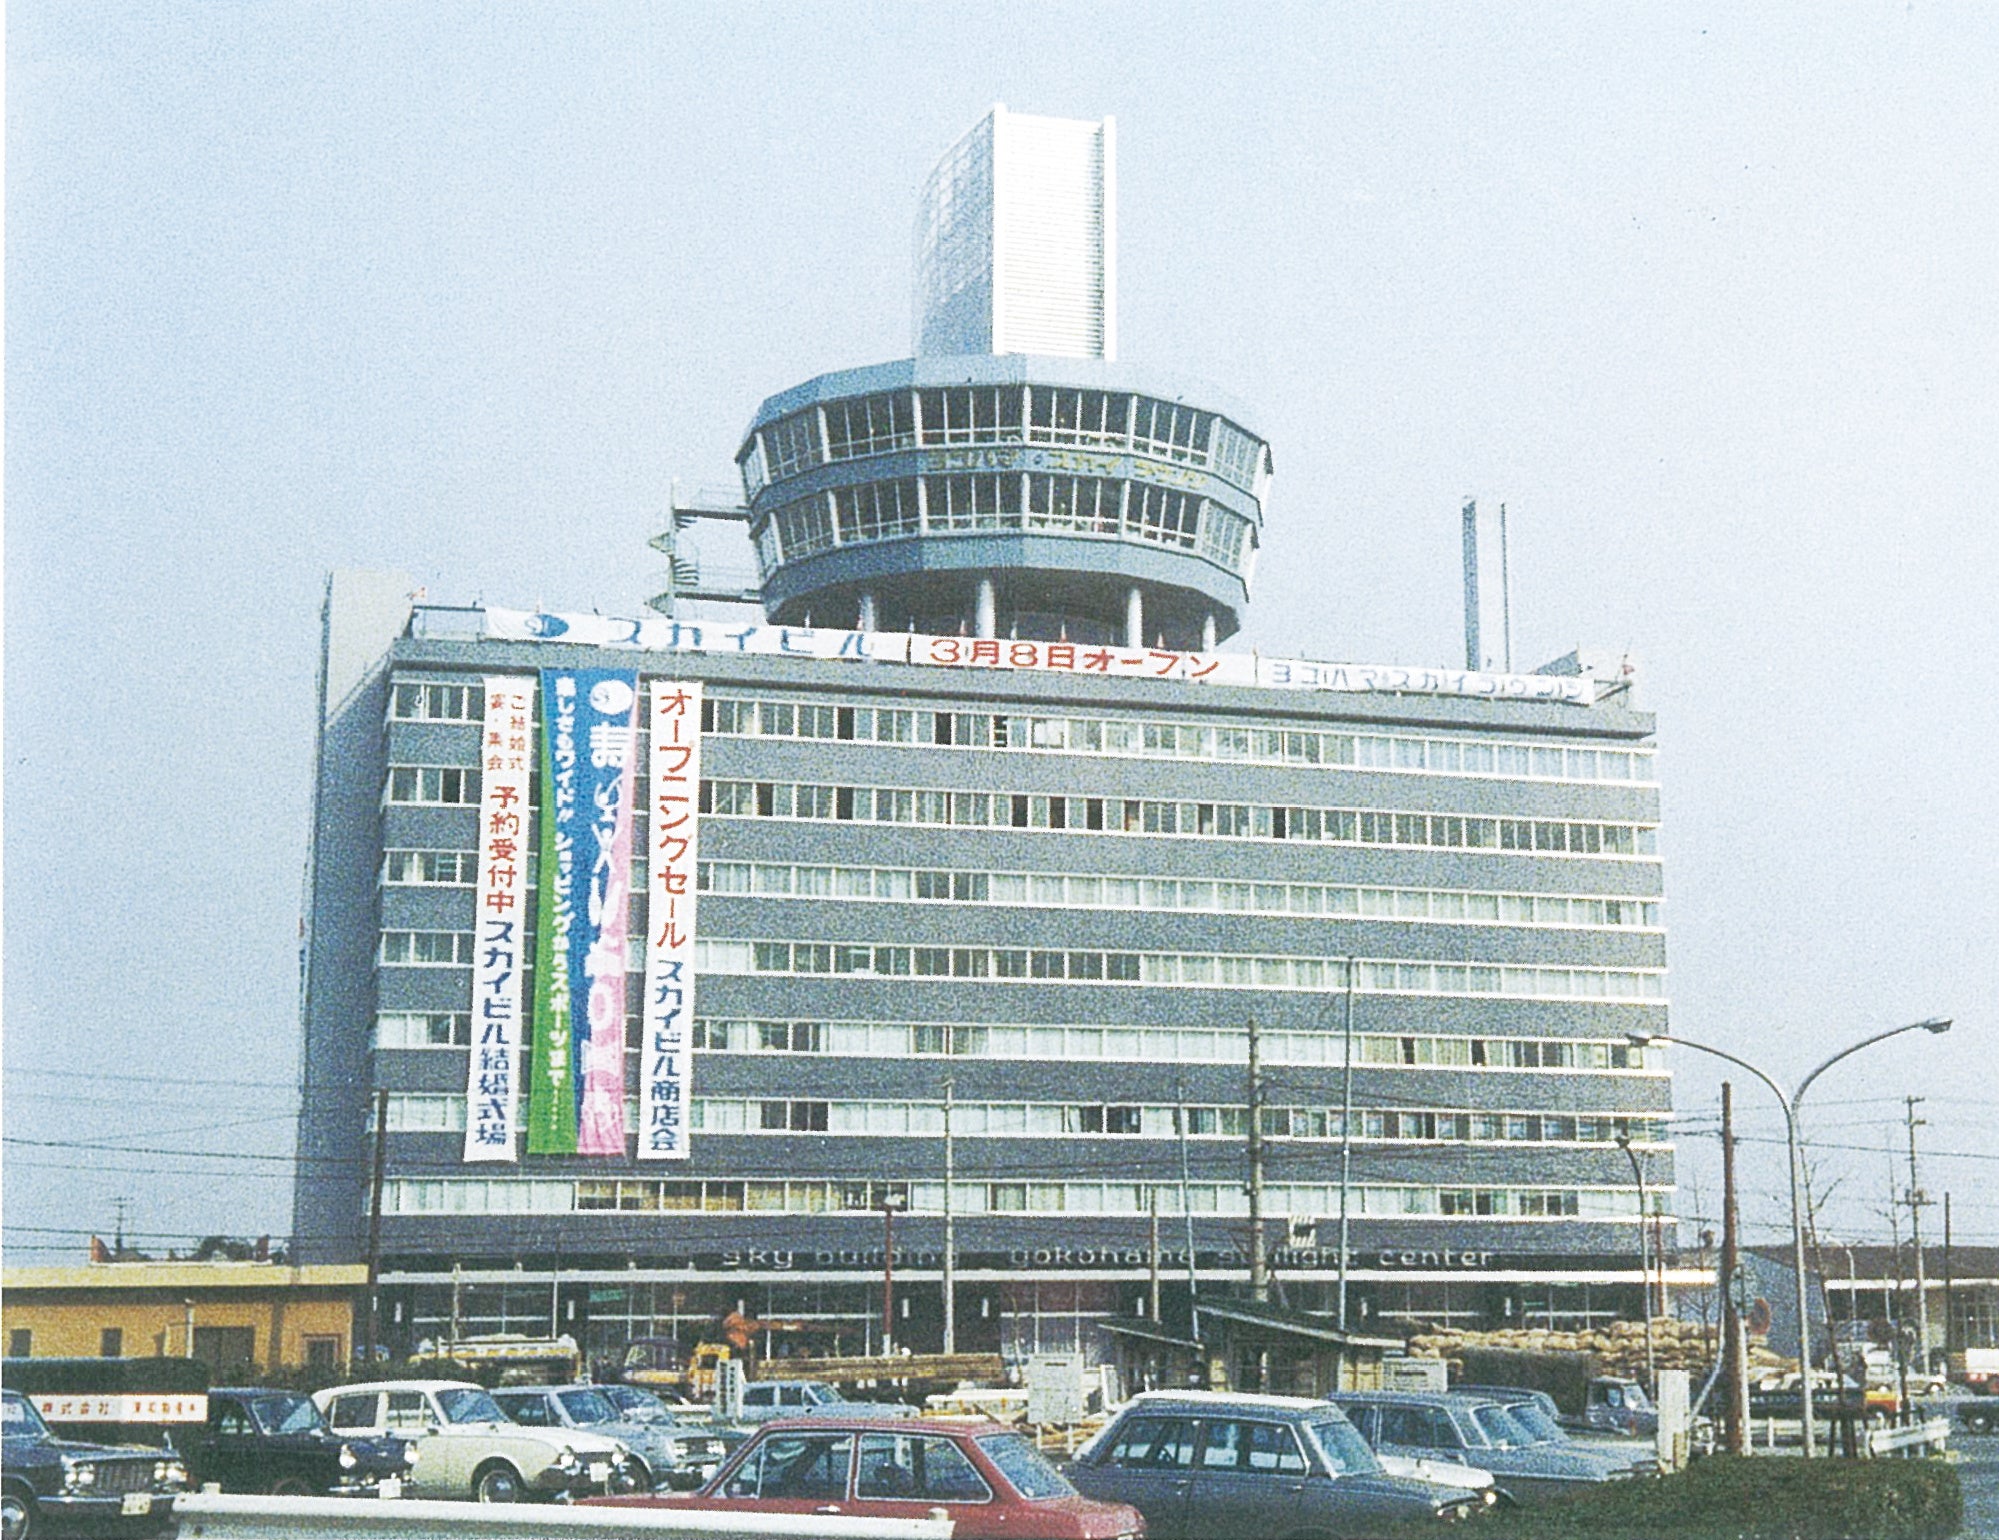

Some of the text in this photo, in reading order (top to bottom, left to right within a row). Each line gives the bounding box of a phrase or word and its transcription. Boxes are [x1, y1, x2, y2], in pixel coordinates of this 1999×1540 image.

[609, 617, 873, 659] スカイビル
[486, 785, 520, 914] 予約受付中
[650, 959, 685, 1152] スカイビル商店会
[721, 1247, 794, 1270] sky
[1379, 1247, 1493, 1267] center
